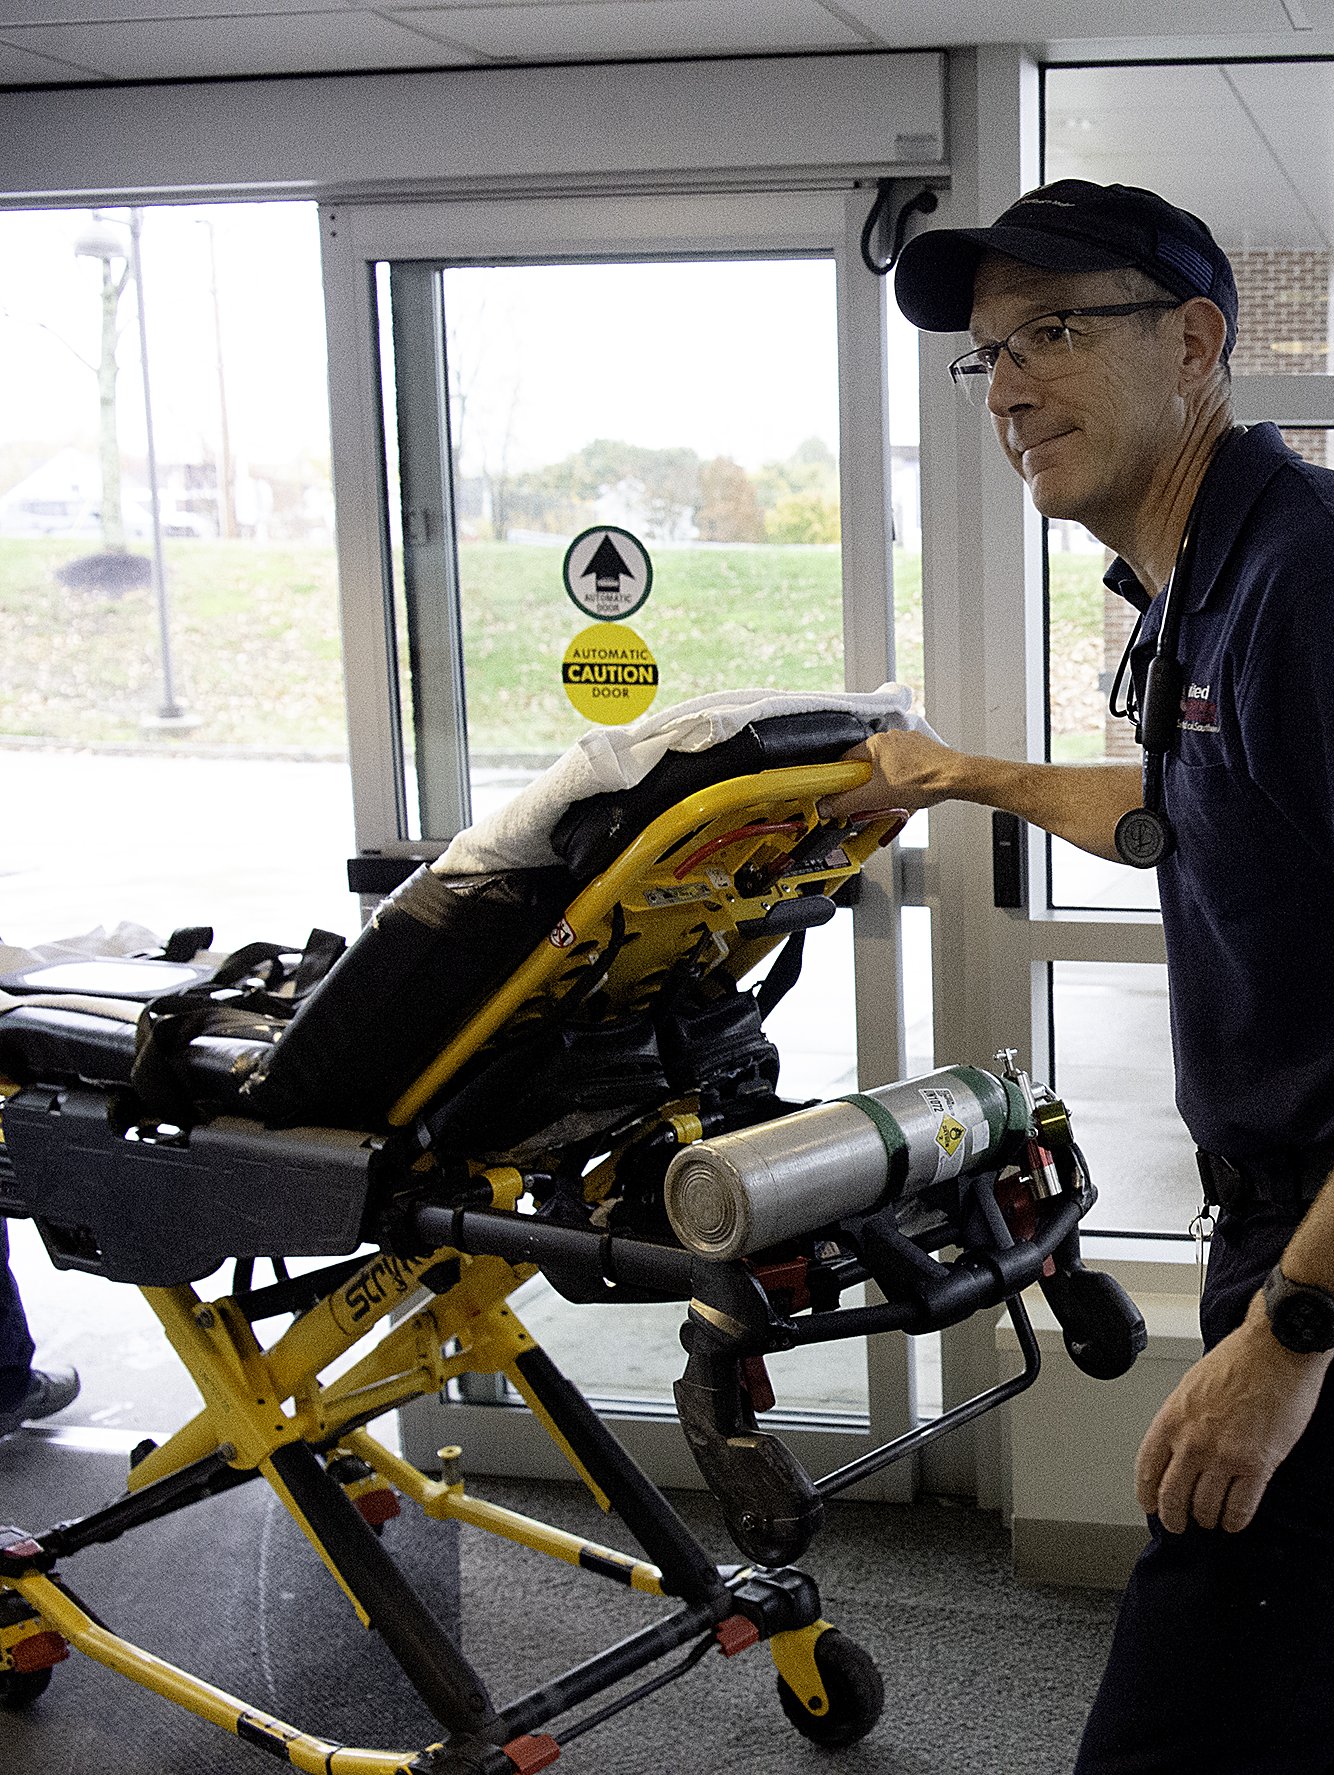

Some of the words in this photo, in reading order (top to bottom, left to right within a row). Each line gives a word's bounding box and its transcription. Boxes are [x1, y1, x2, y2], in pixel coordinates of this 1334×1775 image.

[584, 594, 631, 603] AUTOMATIC
[573, 648, 648, 661] AUTOMATIC
[567, 665, 653, 683] CAUTION
[592, 687, 630, 699] DOOR
